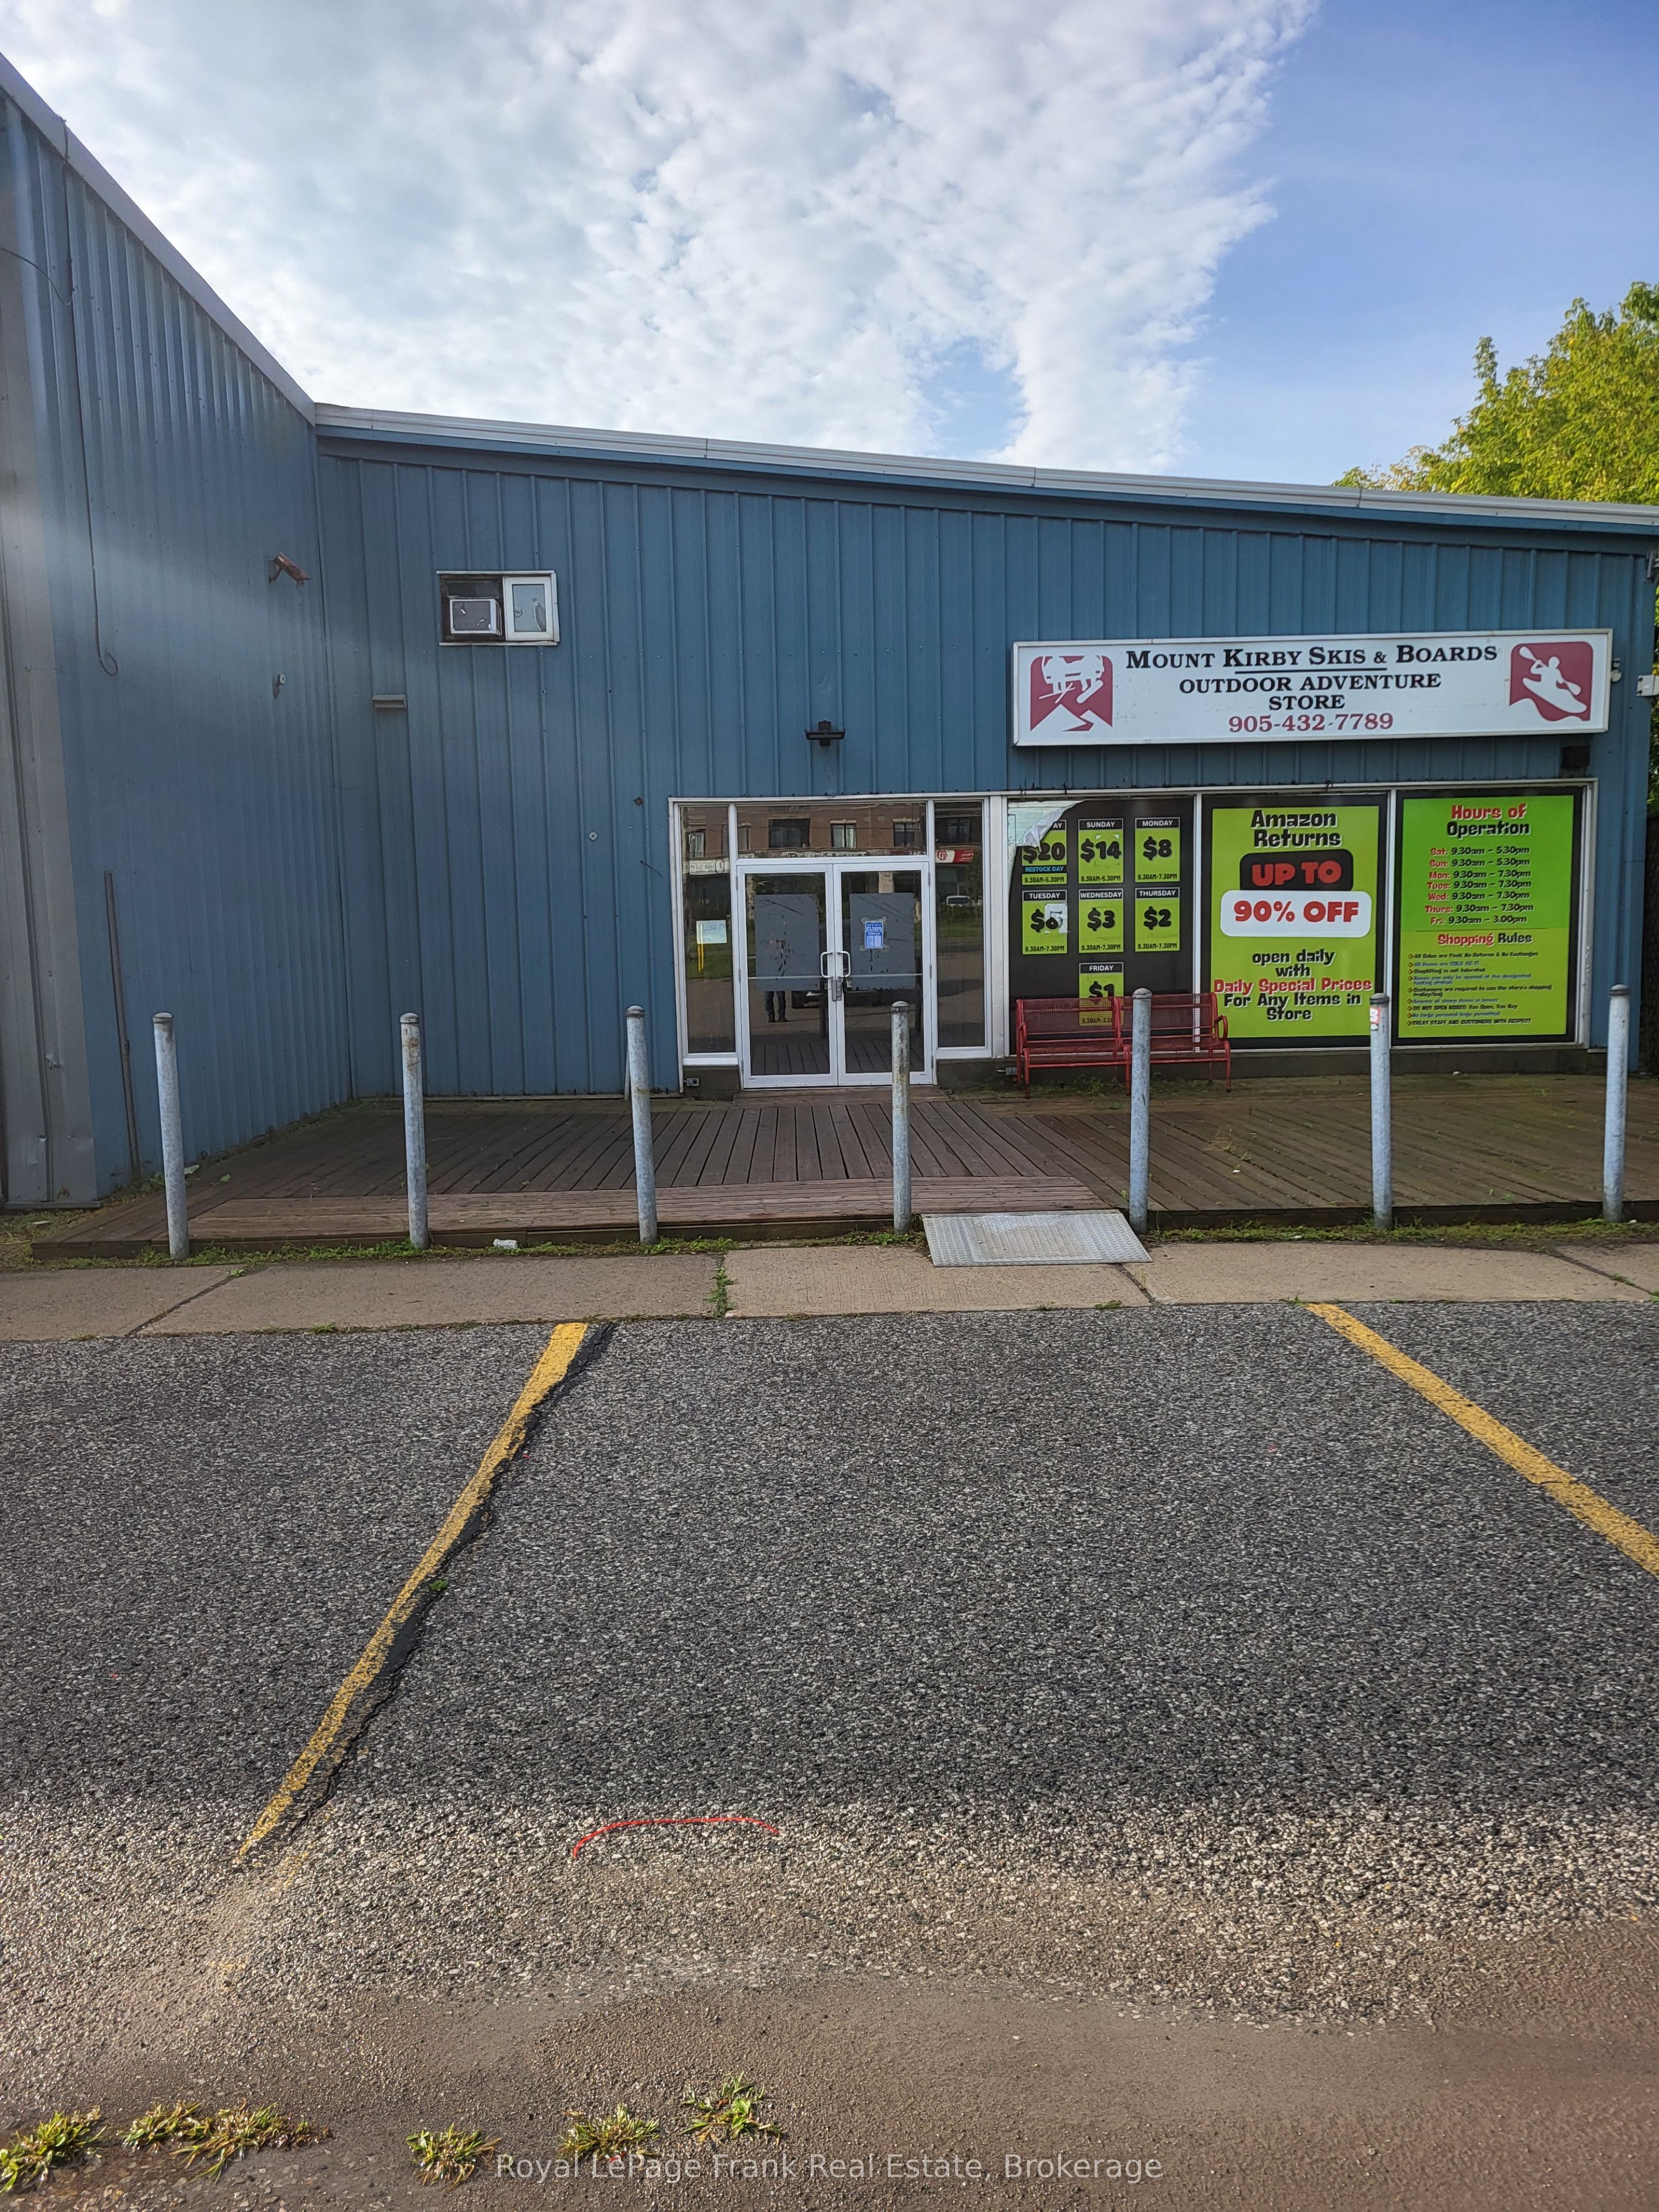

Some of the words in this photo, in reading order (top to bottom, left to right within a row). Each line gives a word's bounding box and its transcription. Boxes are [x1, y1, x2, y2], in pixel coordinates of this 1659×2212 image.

[1126, 650, 1215, 668] MOUNT
[1223, 649, 1303, 667] KIRBY
[1309, 646, 1366, 665] SKIS
[1374, 651, 1388, 664] &
[1396, 645, 1498, 663] BOARDS
[1179, 677, 1293, 694] OUTDOOR
[1300, 673, 1442, 691] ADVENTURE
[1268, 694, 1346, 710] STORE
[1228, 713, 1393, 733] 905-432-7789
[1251, 809, 1337, 828] Amazon
[1451, 805, 1502, 820] Hours
[1508, 803, 1528, 819] of
[1253, 829, 1341, 848] Returns
[1447, 820, 1531, 840] Operation
[1080, 838, 1122, 863] $14
[1143, 836, 1172, 861] $8
[1252, 863, 1296, 887] UP
[1301, 860, 1342, 884] TO
[1087, 907, 1116, 931] $3
[1143, 906, 1172, 930] $2
[1234, 900, 1296, 922] 90%
[1303, 900, 1359, 922] OFF
[1438, 933, 1495, 947] Shopping
[1498, 932, 1533, 944] Rules
[1252, 952, 1291, 967] open
[1296, 949, 1336, 965] daily
[1275, 963, 1310, 978] with
[1089, 980, 1115, 1005] $1
[1214, 979, 1253, 995] Daily
[1259, 978, 1316, 995] Special
[1321, 977, 1373, 991] Prices
[1224, 994, 1251, 1007] For
[1257, 993, 1289, 1009] Any
[1294, 992, 1341, 1006] Items
[1347, 993, 1361, 1006] in
[1266, 1007, 1313, 1021] Store
